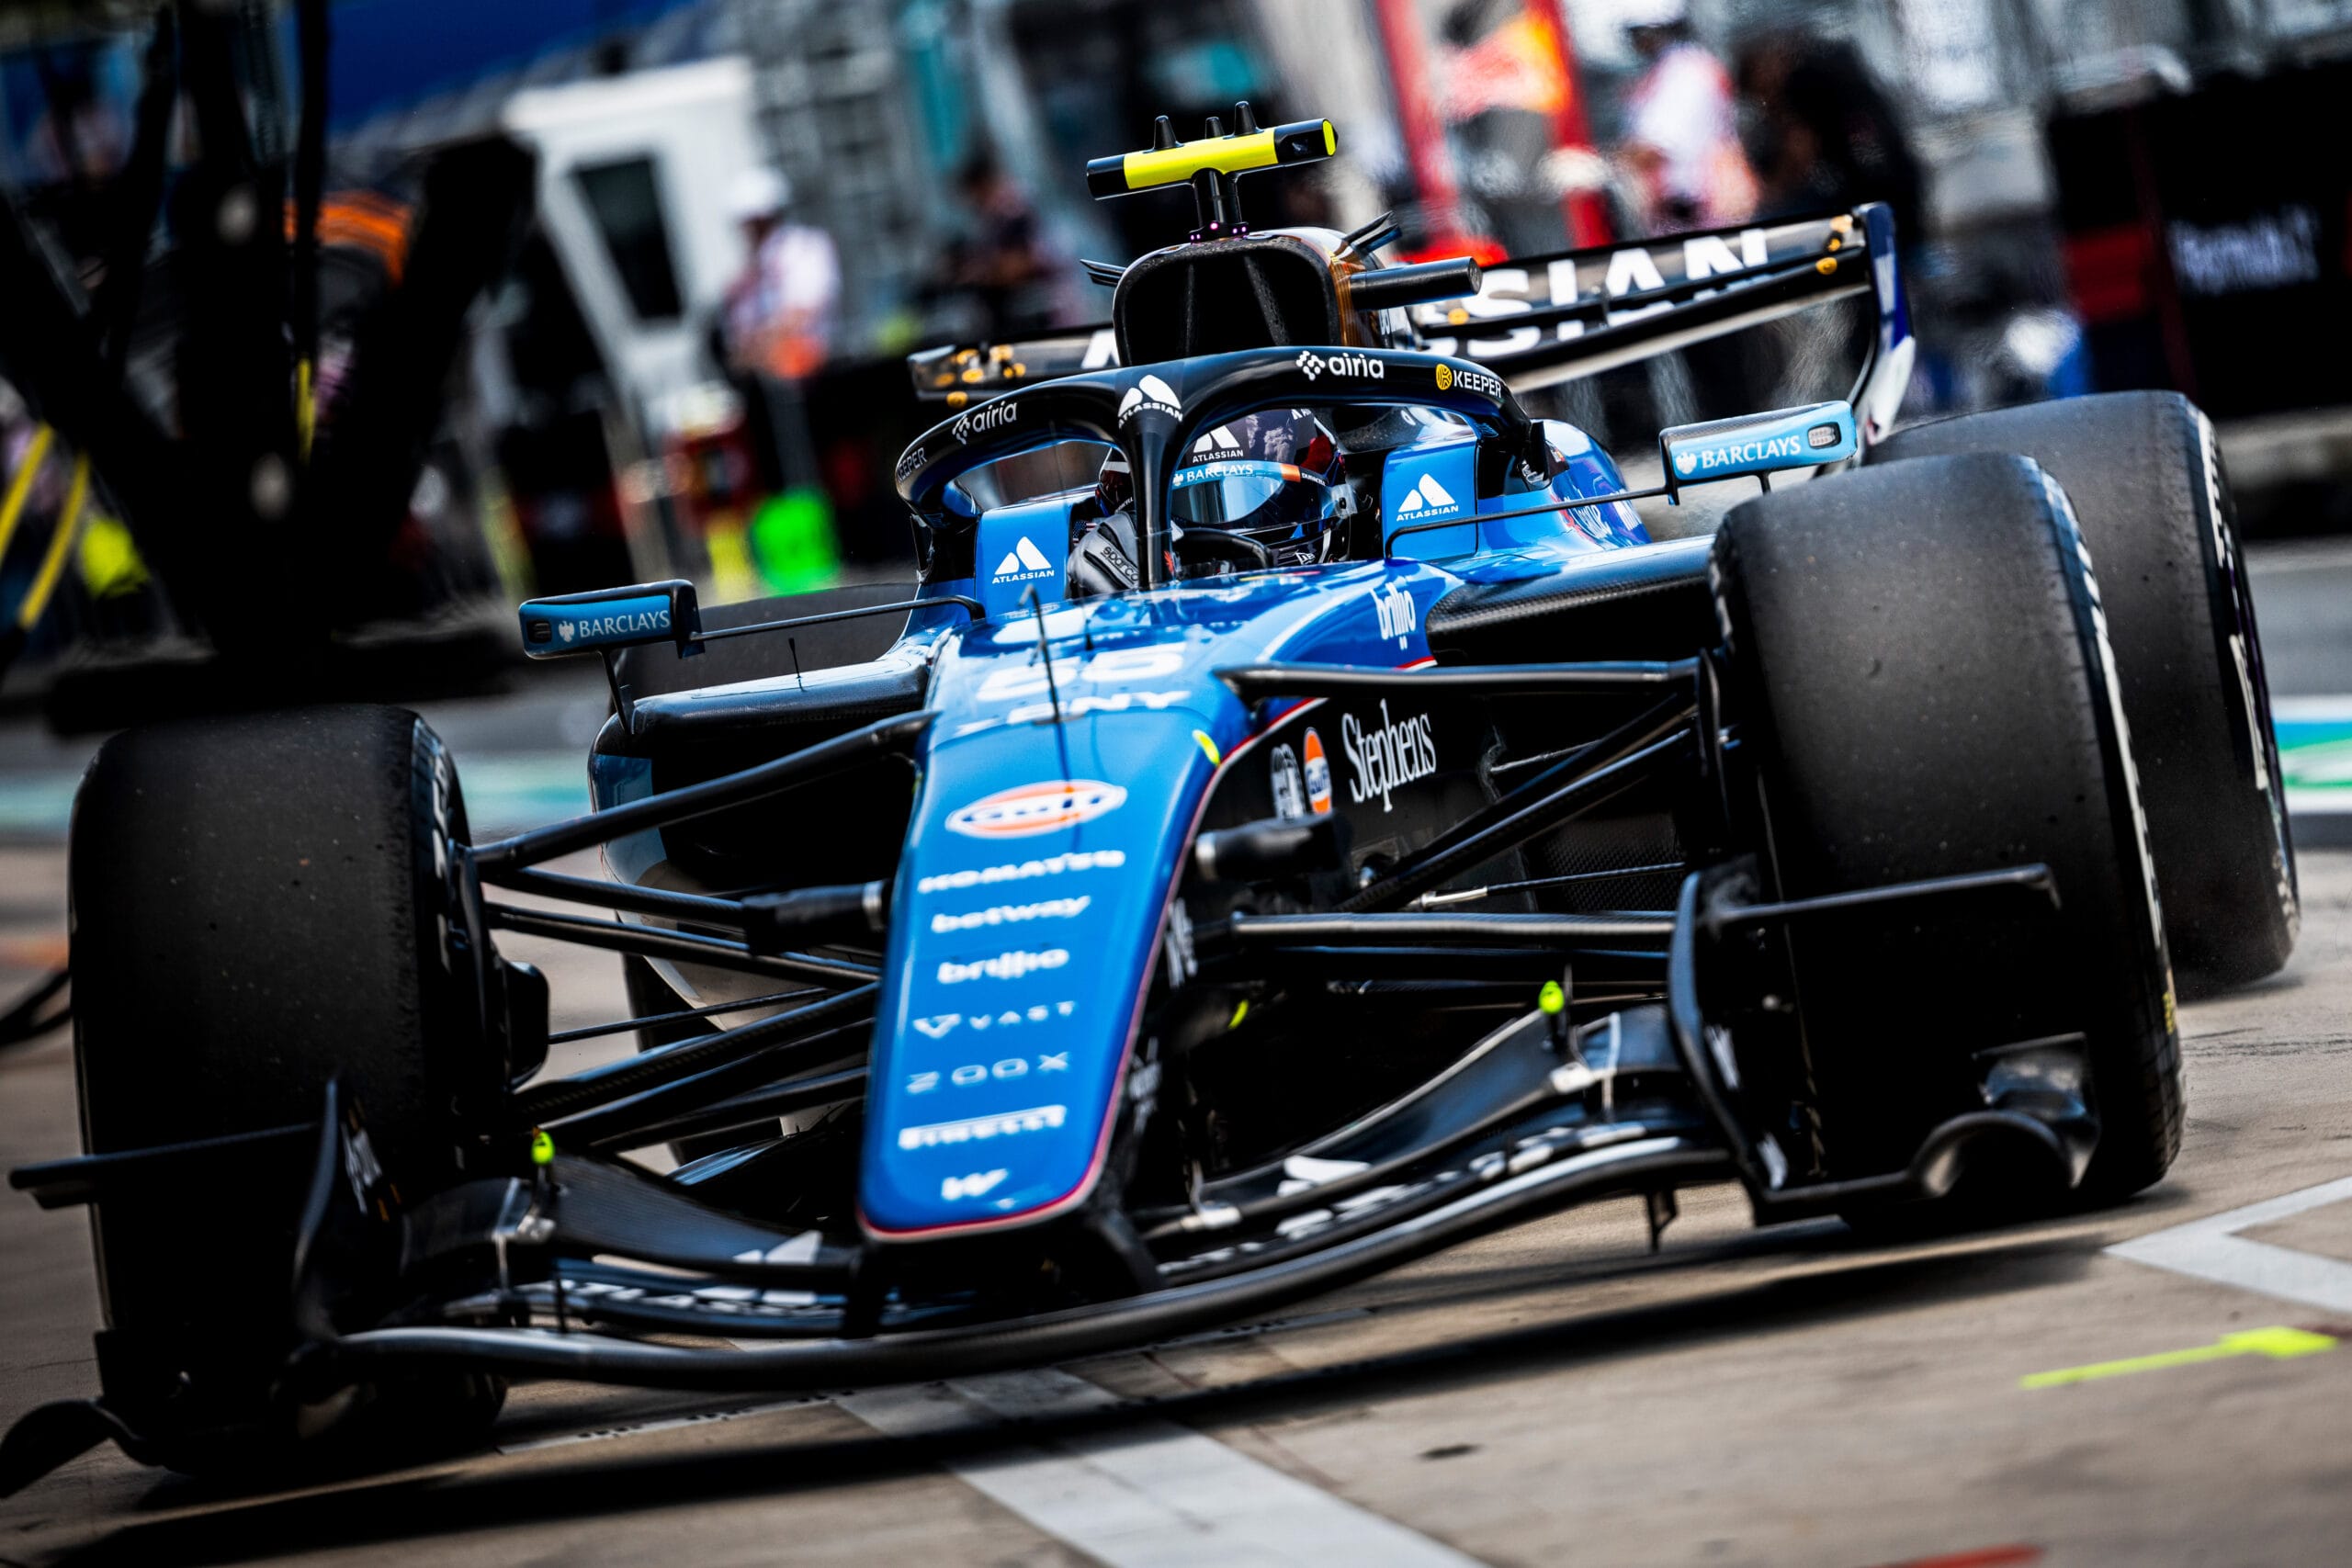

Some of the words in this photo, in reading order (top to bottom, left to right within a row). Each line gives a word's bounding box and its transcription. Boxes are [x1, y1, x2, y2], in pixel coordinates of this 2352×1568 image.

[1329, 353, 1385, 378] airia
[1453, 370, 1501, 398] KEEPER
[972, 400, 1017, 433] airia
[1118, 402, 1183, 429] ATLASSIAN
[1193, 449, 1244, 464] ATLASSIAN
[1702, 435, 1802, 468] BARCLAYS
[1186, 464, 1254, 482] BARCLAYS
[1396, 504, 1459, 522] ATLASSIAN
[992, 570, 1055, 584] ATLASSIAN
[579, 610, 671, 638] BARCLAYS
[1341, 698, 1436, 812] Stephens
